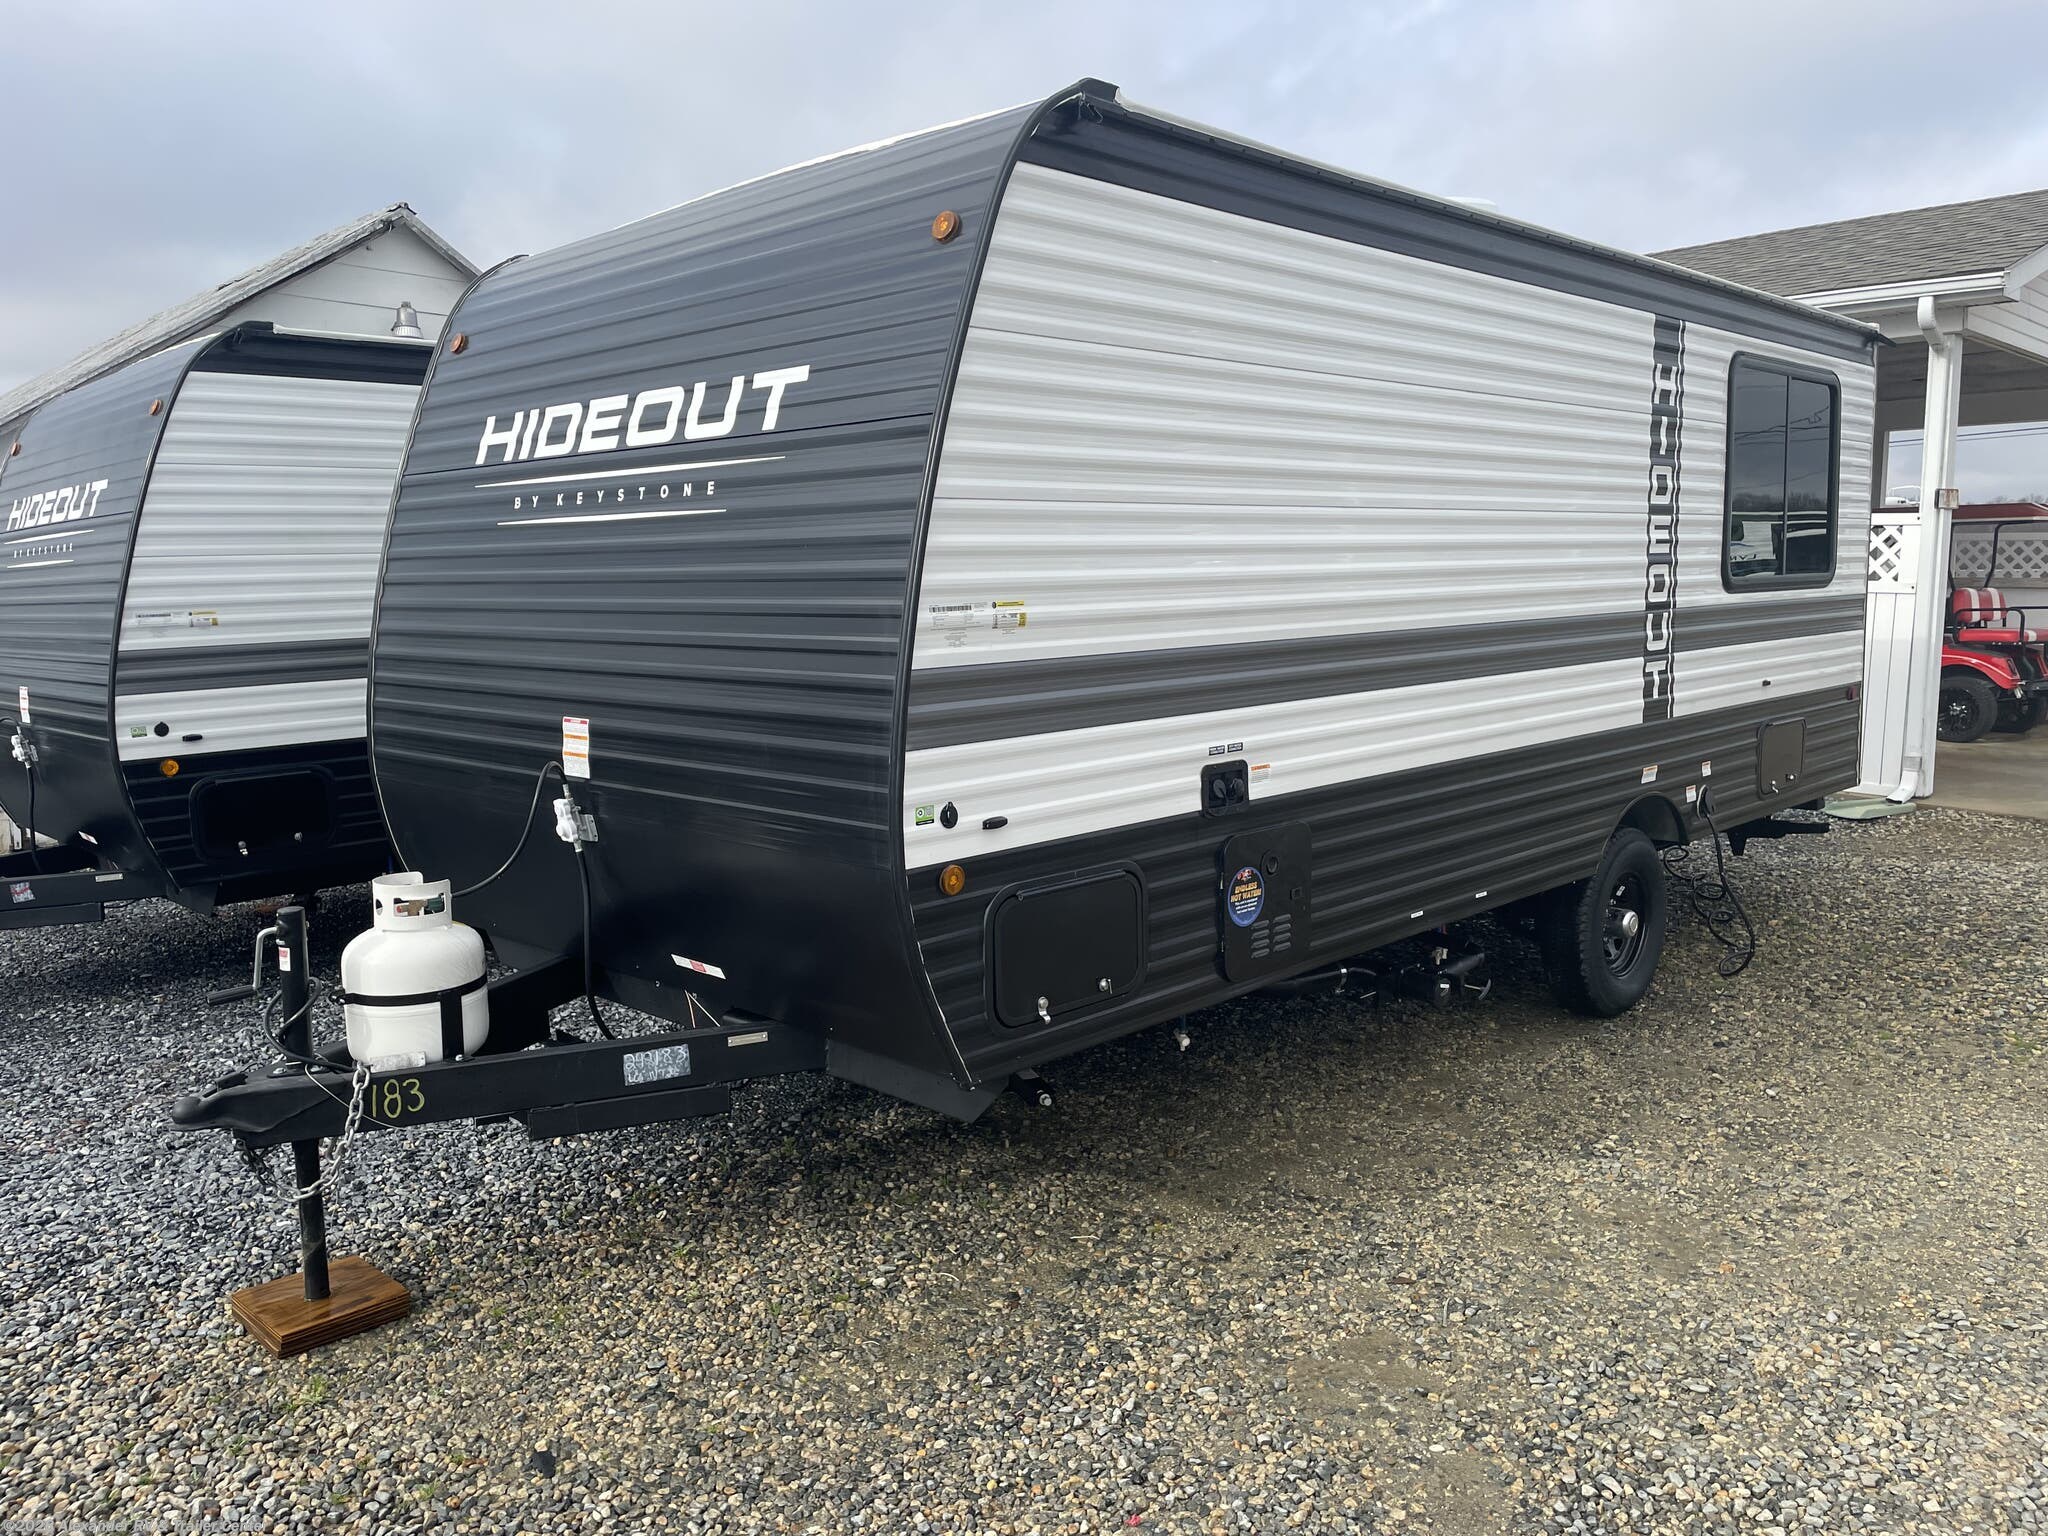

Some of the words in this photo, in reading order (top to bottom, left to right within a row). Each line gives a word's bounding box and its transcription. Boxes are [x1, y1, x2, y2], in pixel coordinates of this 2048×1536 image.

[475, 364, 811, 465] HIDEOUT
[6, 478, 109, 531] HIDEOUT
[513, 495, 539, 510] BY
[556, 480, 715, 506] KEYSTONE
[1645, 363, 1678, 699] HIDEOUT
[372, 1078, 425, 1118] 183
